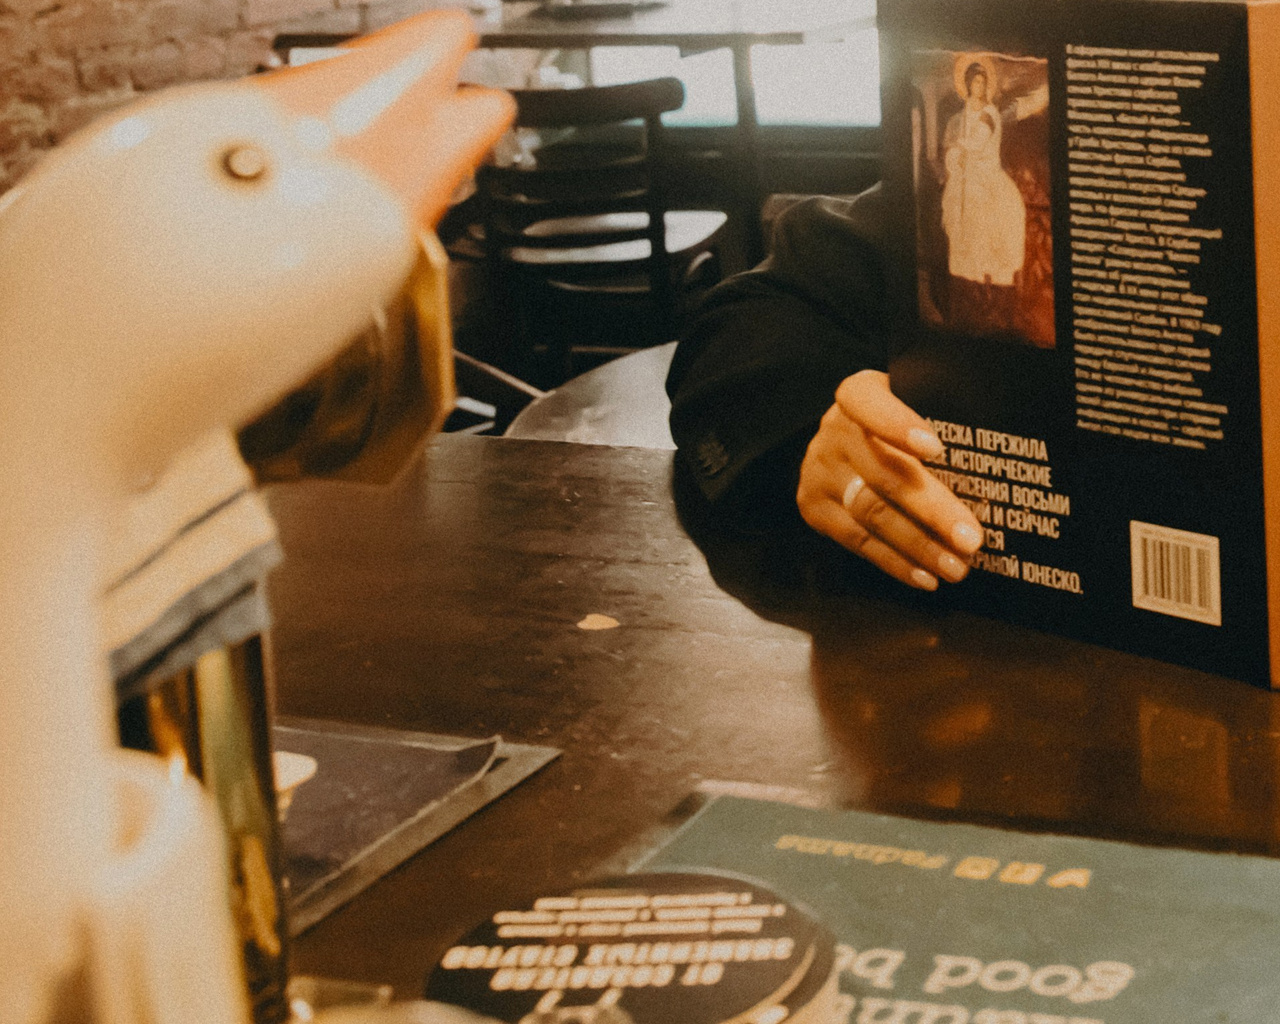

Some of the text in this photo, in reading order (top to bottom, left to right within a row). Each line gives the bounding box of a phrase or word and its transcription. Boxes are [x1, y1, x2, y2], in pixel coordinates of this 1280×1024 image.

[975, 428, 1049, 462] ПЕРЕЖИЛА
[950, 449, 1052, 488] ИСТОРИЧЕСКИЕ
[1012, 484, 1071, 516] ВОСЬМИ
[993, 505, 1004, 527] И
[1006, 507, 1060, 539] СЕЙЧАС
[1022, 561, 1084, 594] ЮНЕСКО.
[923, 953, 1134, 1004] good
